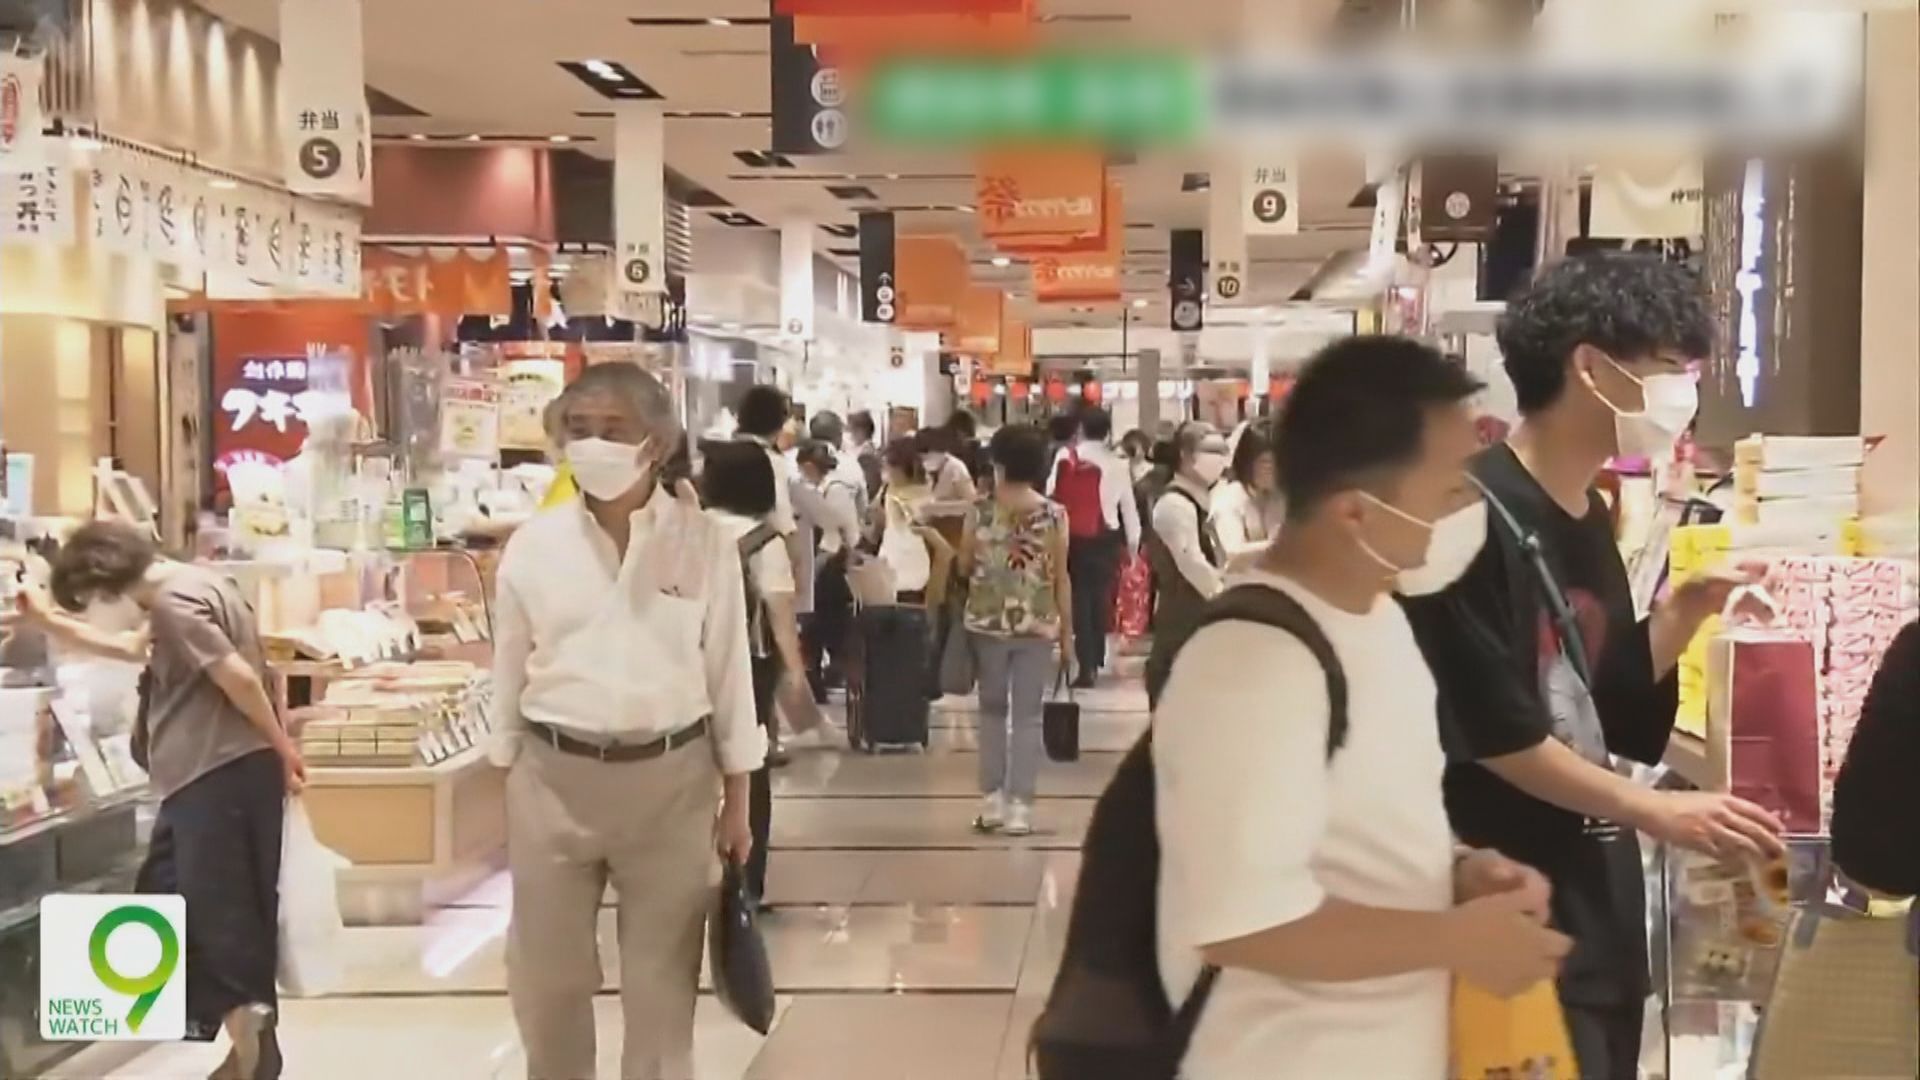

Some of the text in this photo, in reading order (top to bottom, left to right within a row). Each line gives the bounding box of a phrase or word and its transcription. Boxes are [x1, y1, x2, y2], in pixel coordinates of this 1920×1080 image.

[299, 110, 340, 131] 弁当
[1254, 167, 1286, 184] 弁当
[1220, 280, 1238, 295] 10
